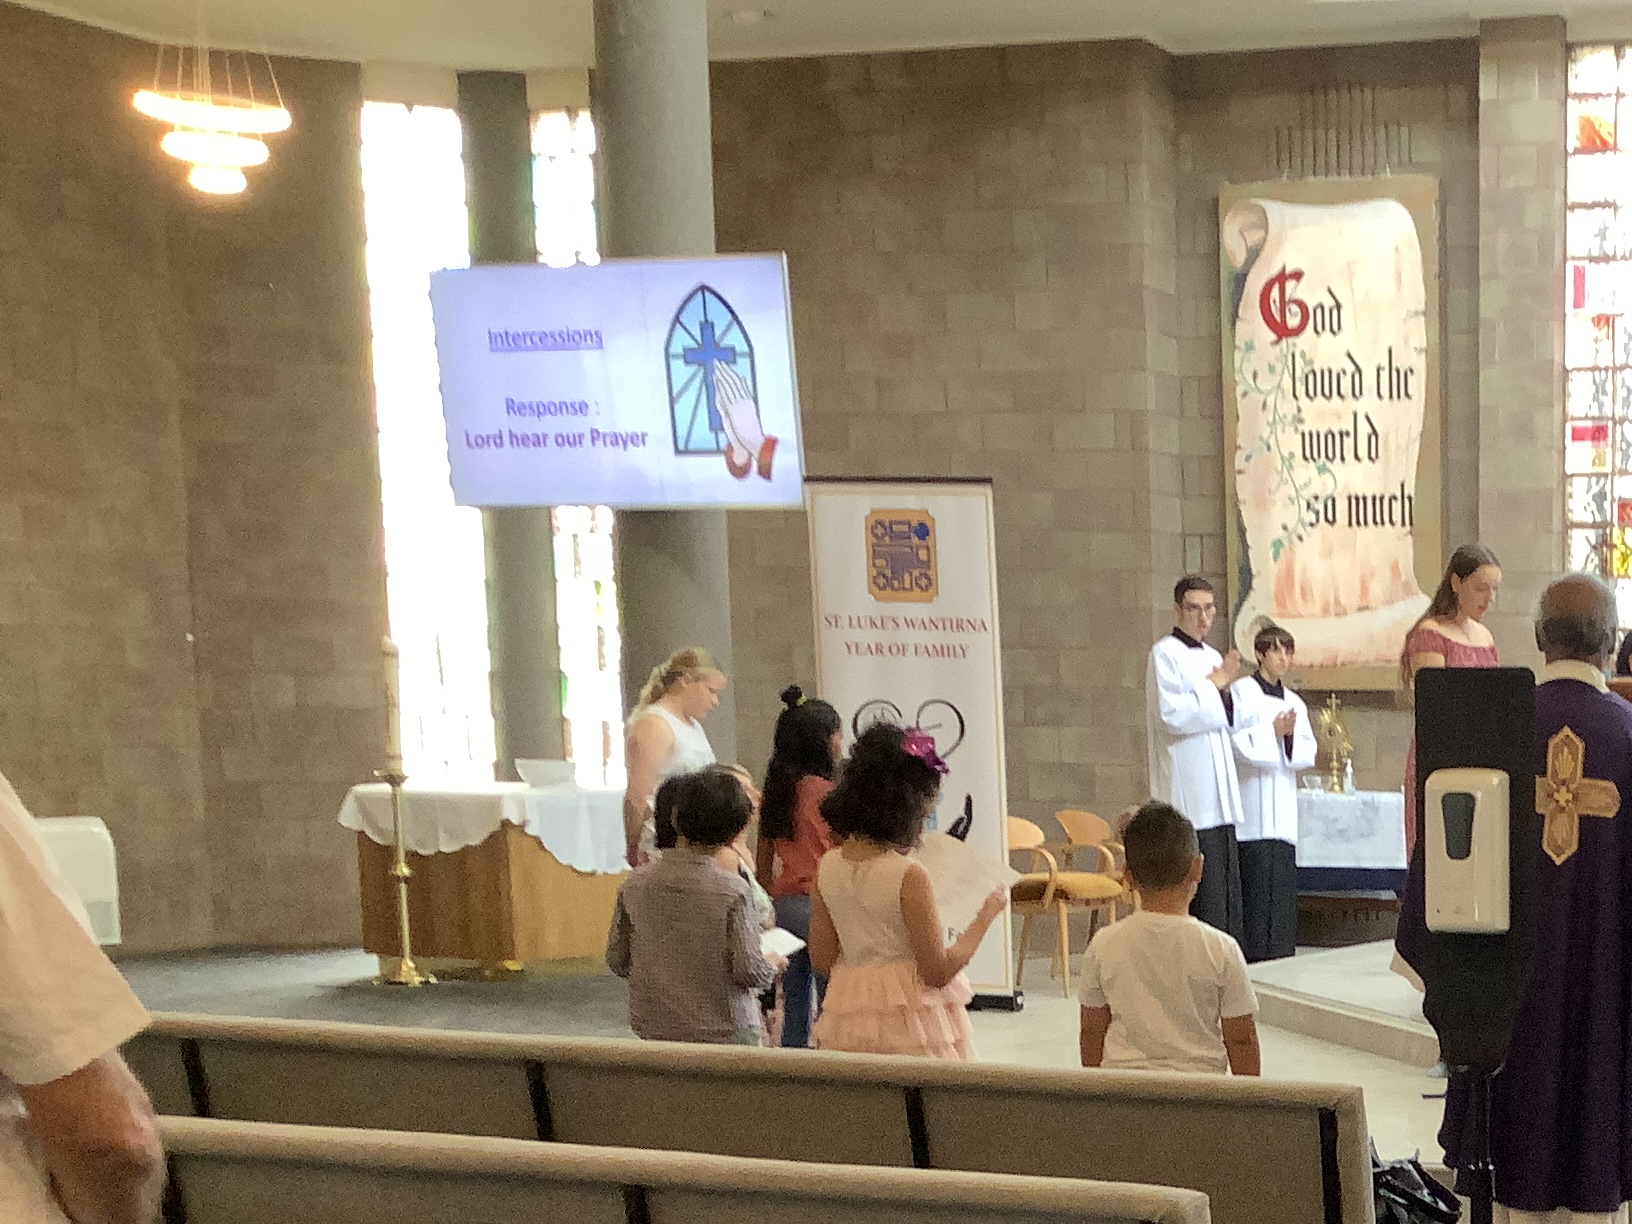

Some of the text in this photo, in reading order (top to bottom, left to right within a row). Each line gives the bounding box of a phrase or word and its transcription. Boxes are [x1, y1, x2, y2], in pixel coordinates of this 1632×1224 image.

[1259, 262, 1343, 346] God
[487, 325, 604, 351] Intercessions
[1291, 346, 1415, 402] loved the
[504, 396, 590, 421] Response
[464, 426, 649, 452] Lord hear our Prayer
[1300, 409, 1379, 465] world
[1305, 479, 1414, 529] so much
[903, 615, 989, 633] WANTIRNA
[844, 641, 971, 659] YEAR OF FAMILY
